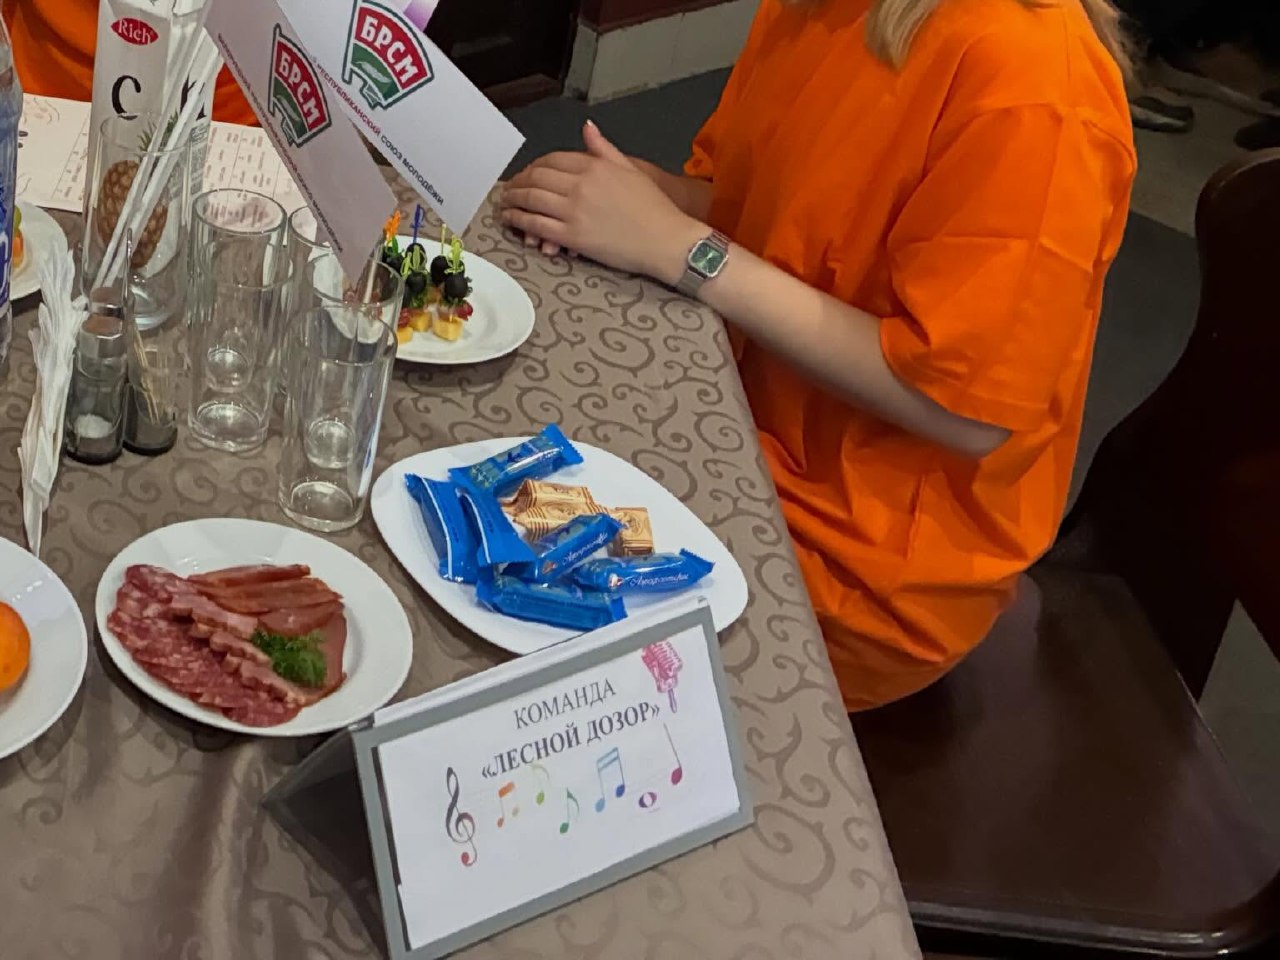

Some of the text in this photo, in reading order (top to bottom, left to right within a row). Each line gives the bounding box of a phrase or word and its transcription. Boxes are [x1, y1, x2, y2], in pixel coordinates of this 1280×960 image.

[117, 17, 152, 44] Rich
[360, 14, 419, 85] БРСМ
[278, 49, 322, 127] БРСМ
[380, 135, 403, 160] СОЮЗ
[512, 677, 617, 730] КОМАНДА
[480, 701, 662, 781] «ЛЕСНОЙ ДОЗОР»
